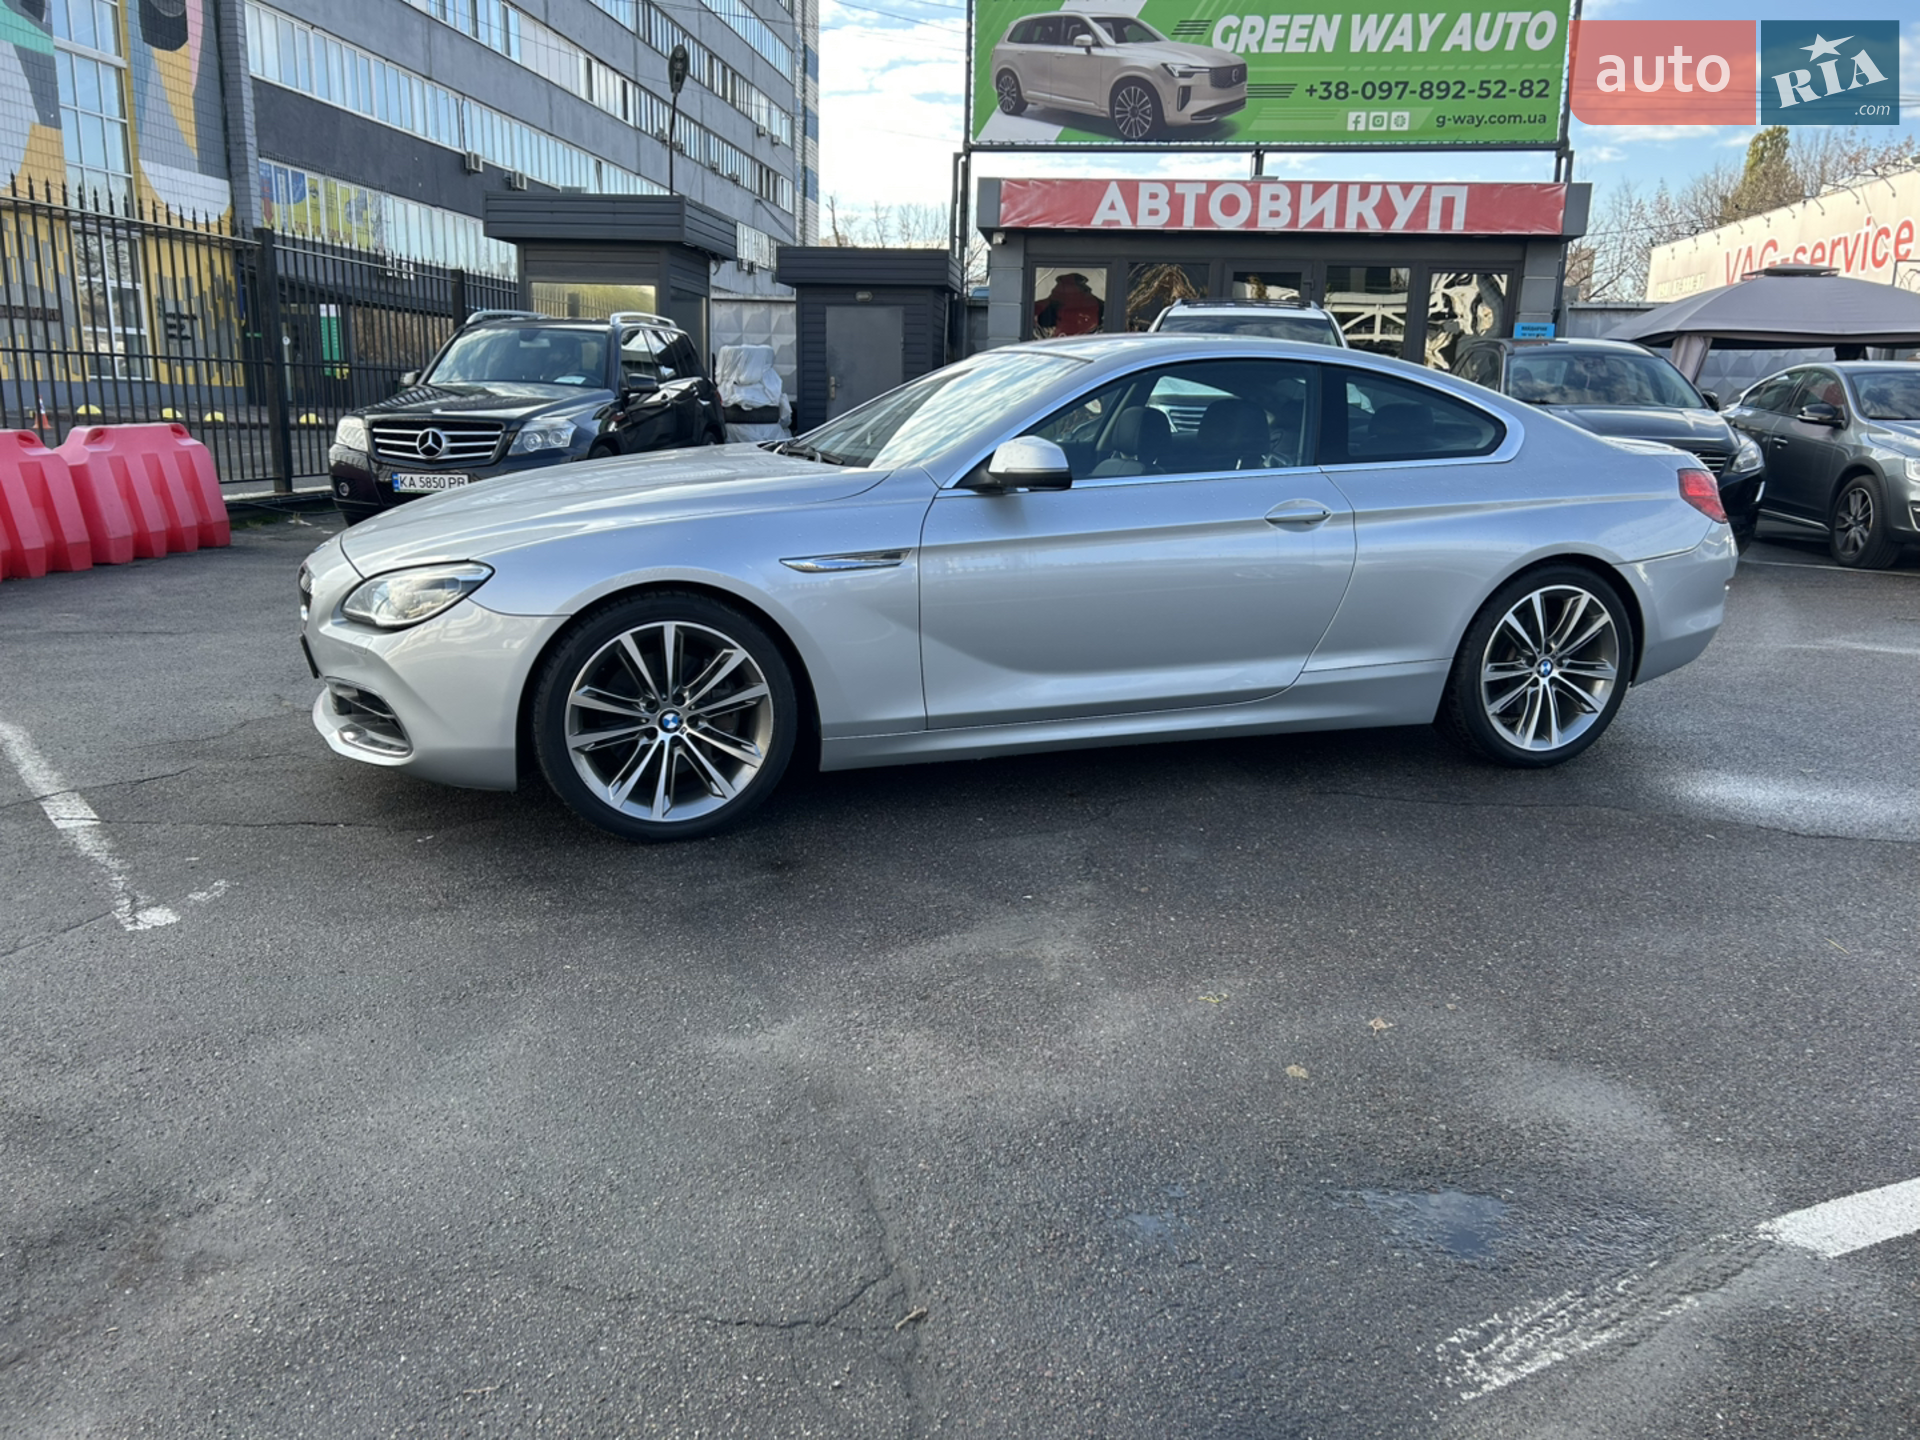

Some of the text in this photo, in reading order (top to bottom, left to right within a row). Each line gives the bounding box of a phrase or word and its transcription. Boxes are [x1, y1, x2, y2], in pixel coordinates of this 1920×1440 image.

[1211, 10, 1557, 54] GREEN WAY AUTO
[1305, 79, 1550, 101] +38-097-892-52-82
[1435, 113, 1547, 128] g-way.com.ua
[1090, 181, 1468, 232] АВТОВИКУП
[399, 475, 416, 488] KA
[419, 476, 446, 489] 5850
